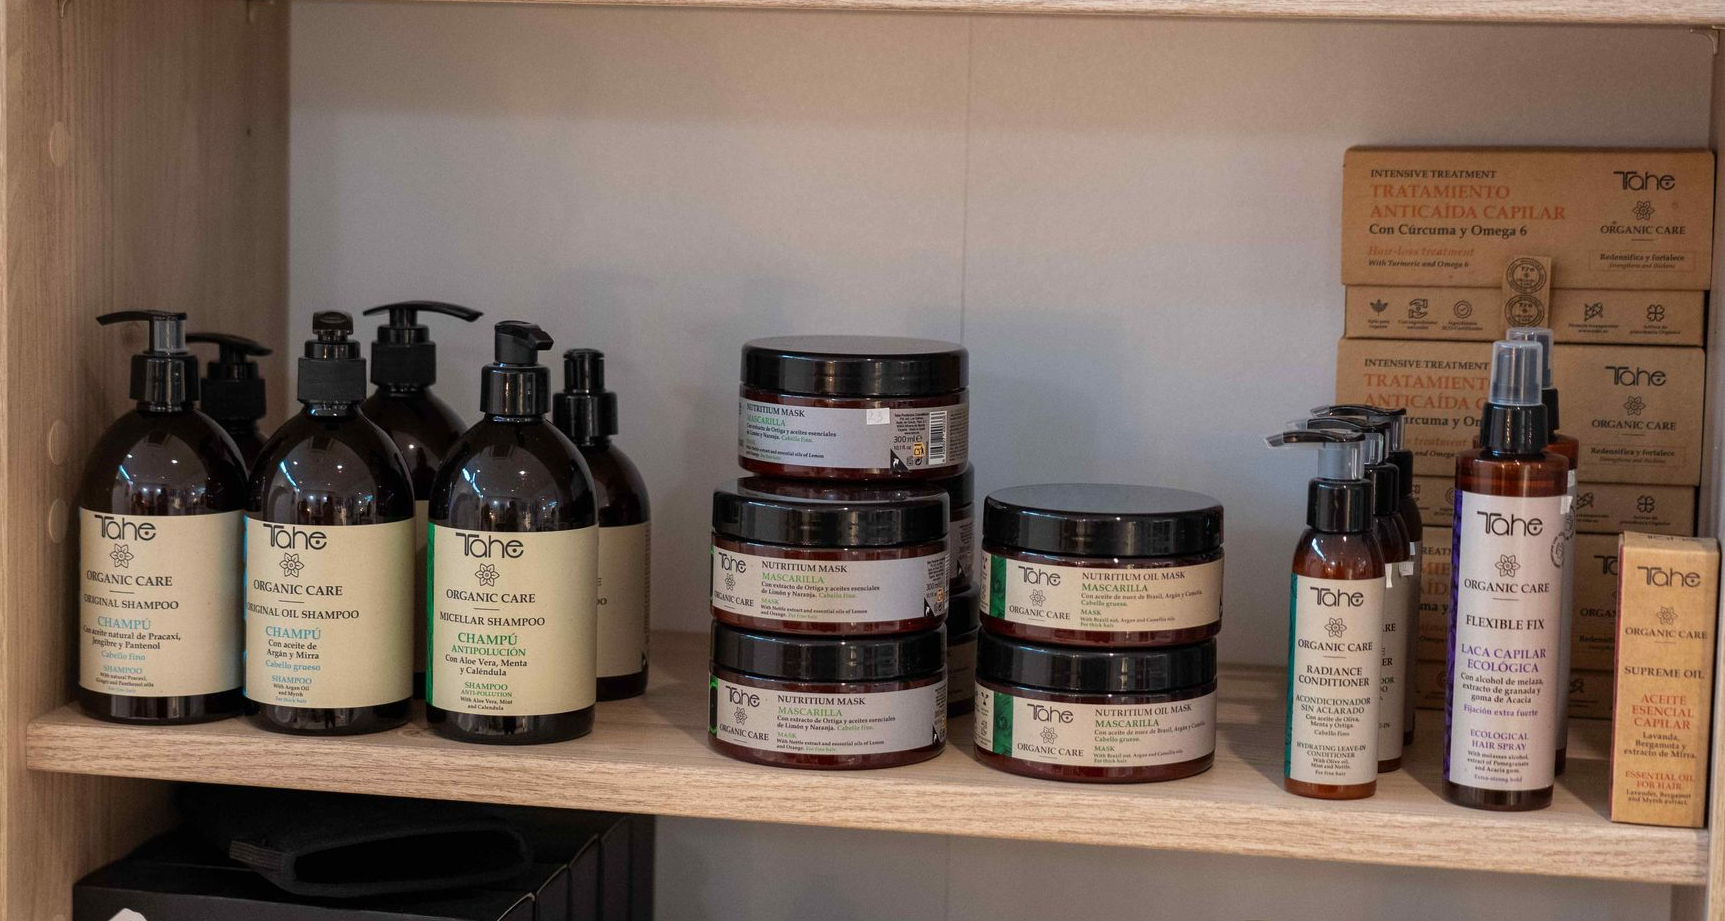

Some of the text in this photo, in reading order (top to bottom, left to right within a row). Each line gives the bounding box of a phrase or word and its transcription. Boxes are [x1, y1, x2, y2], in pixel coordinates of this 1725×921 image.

[1370, 169, 1497, 179] INTENSIVE TREATMENT
[1613, 171, 1675, 191] Tahe
[1370, 184, 1510, 200] TRATAMIENTO
[1370, 202, 1566, 220] ANTICAÍDA CAPILAR
[1369, 223, 1528, 239] Con Cúrcuma y Omega 6
[1600, 225, 1686, 235] ORGANIC CARE
[1364, 358, 1489, 371] INTENSIVE TREATMENT
[1363, 373, 1490, 391] TRATAMIENT
[1605, 366, 1667, 387] Tahe
[1363, 391, 1470, 410] ANTICAÍDA
[781, 408, 805, 418] MASK
[1591, 419, 1676, 431] ORGANIC CARE
[893, 435, 907, 443] 300
[94, 514, 156, 541] Tahe
[1477, 510, 1543, 537] Tahe
[263, 523, 327, 550] Tahe
[455, 532, 524, 559] Tahe
[718, 552, 747, 574] Tahe
[761, 560, 848, 573] NUTRITIUM MASK
[86, 570, 173, 587] ORGANIC CARE
[762, 572, 825, 584] MASCARILLA
[1018, 565, 1061, 587] Tahe
[1082, 571, 1186, 581] NUTRITIUM OIL MASK
[1637, 566, 1701, 588] Tahe
[254, 579, 343, 596] ORGANIC CARE
[773, 582, 796, 591] extracto
[1081, 583, 1148, 592] MASCARILLA
[1464, 578, 1550, 594] ORGANIC CARE
[83, 593, 179, 610] ORIGINAL SHAMPOO
[446, 588, 535, 603] ORGANIC CARE
[735, 597, 754, 607] CARE
[1310, 586, 1364, 607] Tahe
[281, 608, 299, 618] OIL
[301, 610, 359, 620] SHAMPOO
[1009, 604, 1071, 620] ORGANIC CARE
[97, 616, 152, 631] CHAMPÚ
[439, 611, 545, 627] MICELLAR SHAMPOO
[1466, 614, 1545, 630] FLEXIBLE FIX
[108, 631, 134, 640] natural
[136, 632, 146, 640] de
[265, 625, 321, 640] CHAMPÚ
[457, 632, 518, 646] CHAMPÚ
[1625, 627, 1708, 639] ORGANIC CARE
[92, 637, 161, 650] Jengibre y Pantenol
[268, 639, 317, 650] Con aceite de
[1298, 638, 1373, 652] ORGANIC CARE
[101, 650, 146, 661] Cabello fino
[266, 649, 319, 660] Argán y Mirra
[451, 644, 526, 657] ANTIPOLUCIÓN
[1461, 643, 1547, 659] LACA CAPILAR
[265, 660, 321, 672] Cabello grueso
[445, 654, 527, 667] Con Aloe Vera, Menta
[1467, 659, 1539, 673] ECOLÓGICA
[459, 666, 507, 677] y Caléndula
[1306, 664, 1362, 676] RADIANCE
[1624, 665, 1705, 679] SUPREME OIL
[271, 674, 312, 685] SHAMPOO
[1298, 674, 1370, 687] CONDITIONER
[1460, 672, 1474, 681] Con
[1475, 675, 1504, 685] alcohol
[1505, 677, 1516, 686] de
[464, 681, 508, 691] SHAMPOO
[1462, 683, 1541, 696] extracto de granada y
[725, 685, 760, 708] Tahe
[777, 694, 866, 706] NUTRITIUM MASK
[1295, 694, 1371, 706] ACONDICIONADOR
[1471, 694, 1532, 704] goma de Acacia
[1640, 693, 1687, 705] ACEITE
[778, 706, 843, 717] MASCARILLA
[1027, 703, 1074, 724] Tahe
[1095, 703, 1192, 717] NUTRITIUM OIL MASK
[1300, 704, 1365, 715] SIN ACLARADO
[1463, 703, 1538, 717] Fijación extra fuerte
[1631, 705, 1695, 718] ESENCIAL
[1095, 719, 1159, 728] MASCARILLA
[1633, 717, 1691, 730] CAPILAR
[719, 723, 769, 741] ORGANIC CARE
[1470, 729, 1529, 740] ECOLOGICAL
[1017, 742, 1084, 757] ORGANIC CARE
[1296, 742, 1367, 752] HYDRATING LEAVE-IN
[1471, 740, 1527, 751] HAIR SPRAY
[1306, 750, 1355, 758] CONDITIONER
